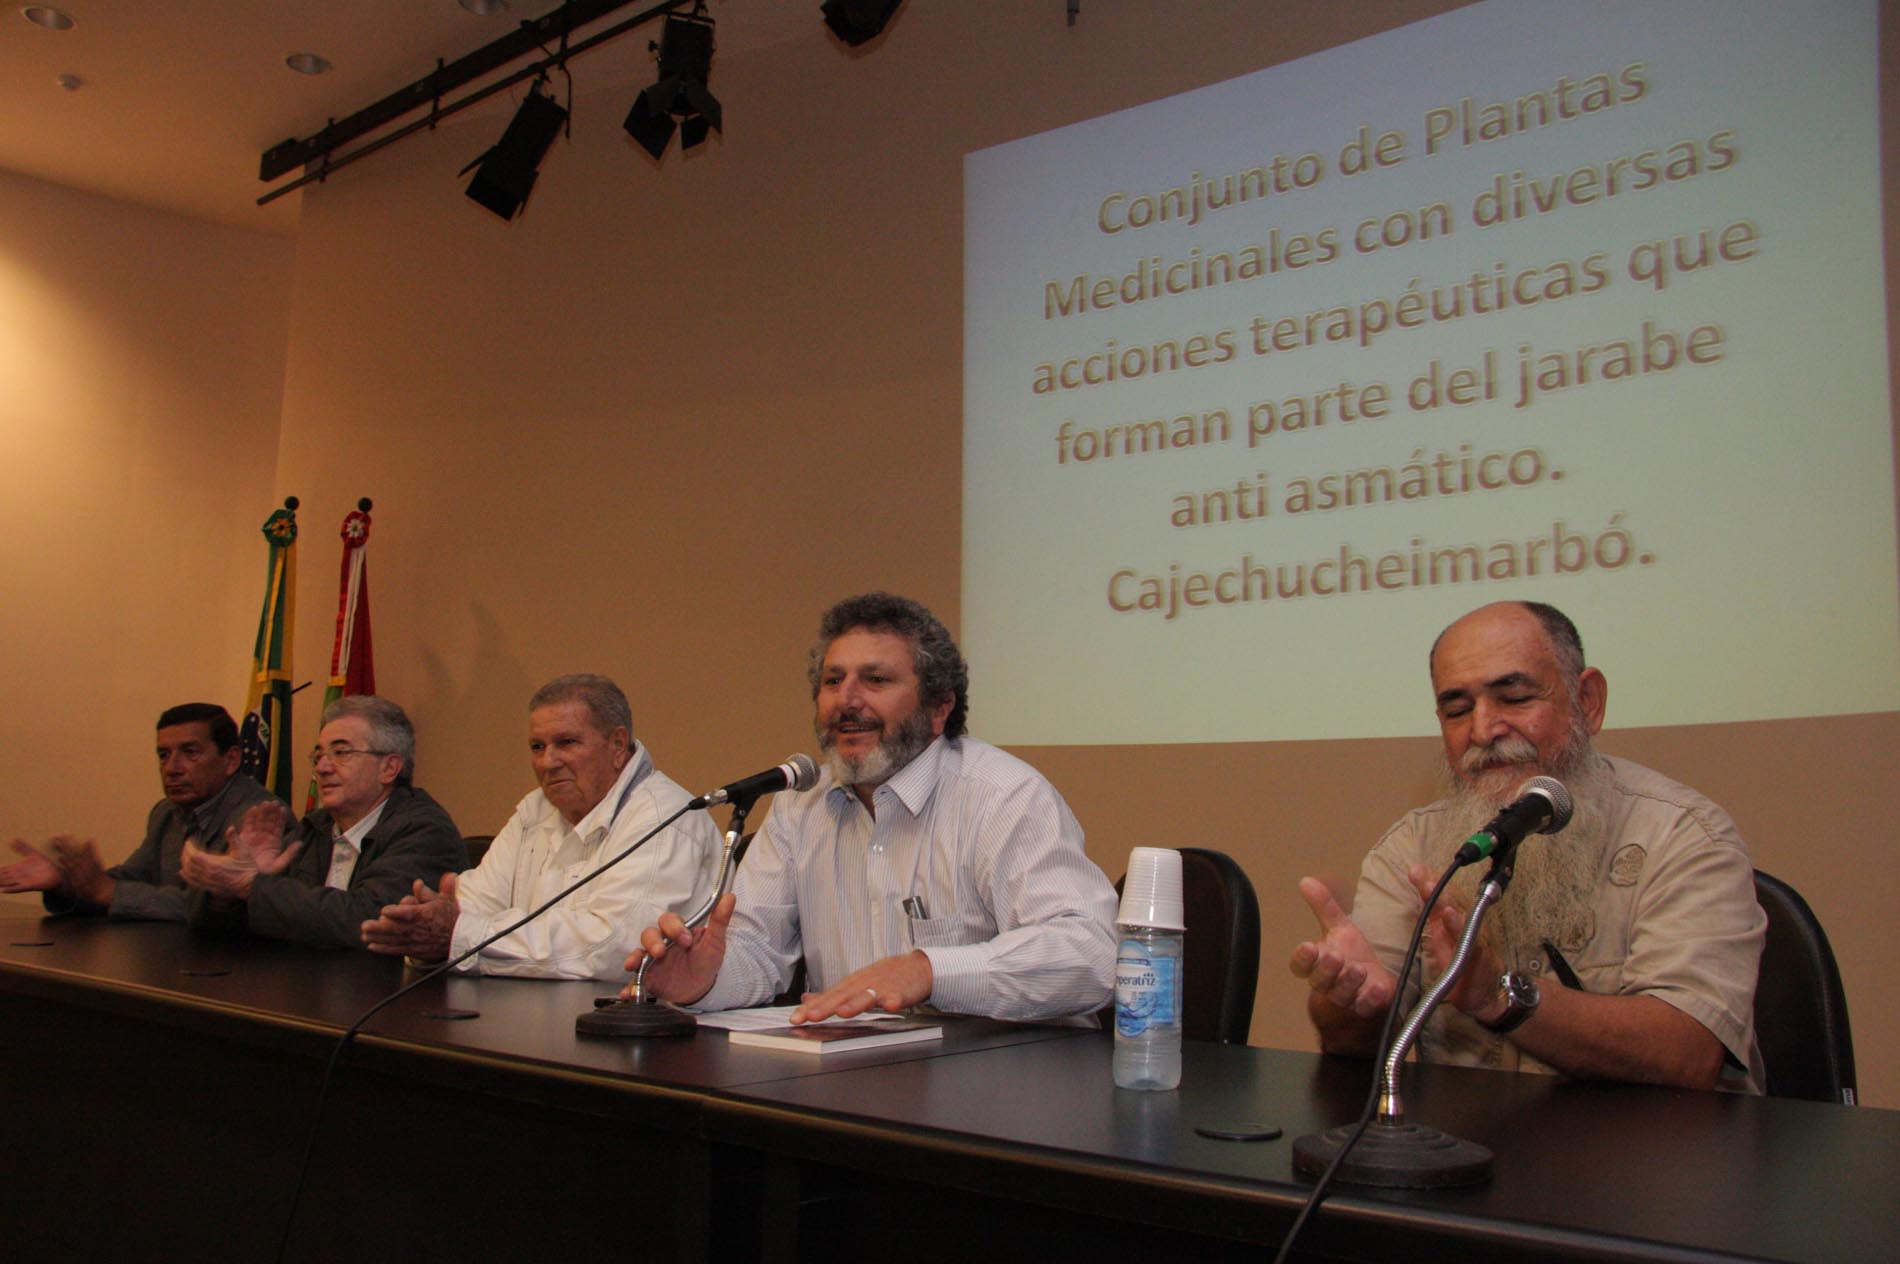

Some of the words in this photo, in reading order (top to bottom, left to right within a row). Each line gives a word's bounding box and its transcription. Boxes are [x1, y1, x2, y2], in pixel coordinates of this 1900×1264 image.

[1044, 228, 1342, 320] Medicinales
[1355, 203, 1453, 253] con
[1472, 127, 1741, 228] diversas
[1099, 150, 1323, 233] Conjunto
[1339, 124, 1408, 175] de
[1425, 62, 1651, 155] Plantas
[1033, 327, 1236, 395] acciones
[1250, 252, 1611, 355] terapéuticas
[1629, 219, 1762, 290] que
[1056, 408, 1232, 465] forman
[1248, 380, 1390, 447] parte
[1407, 350, 1498, 413] del
[1514, 321, 1724, 408] jarabe
[1170, 471, 1268, 527] anti
[1284, 443, 1566, 514] asmático.
[1107, 511, 1656, 619] Cajechucheimarbó.
